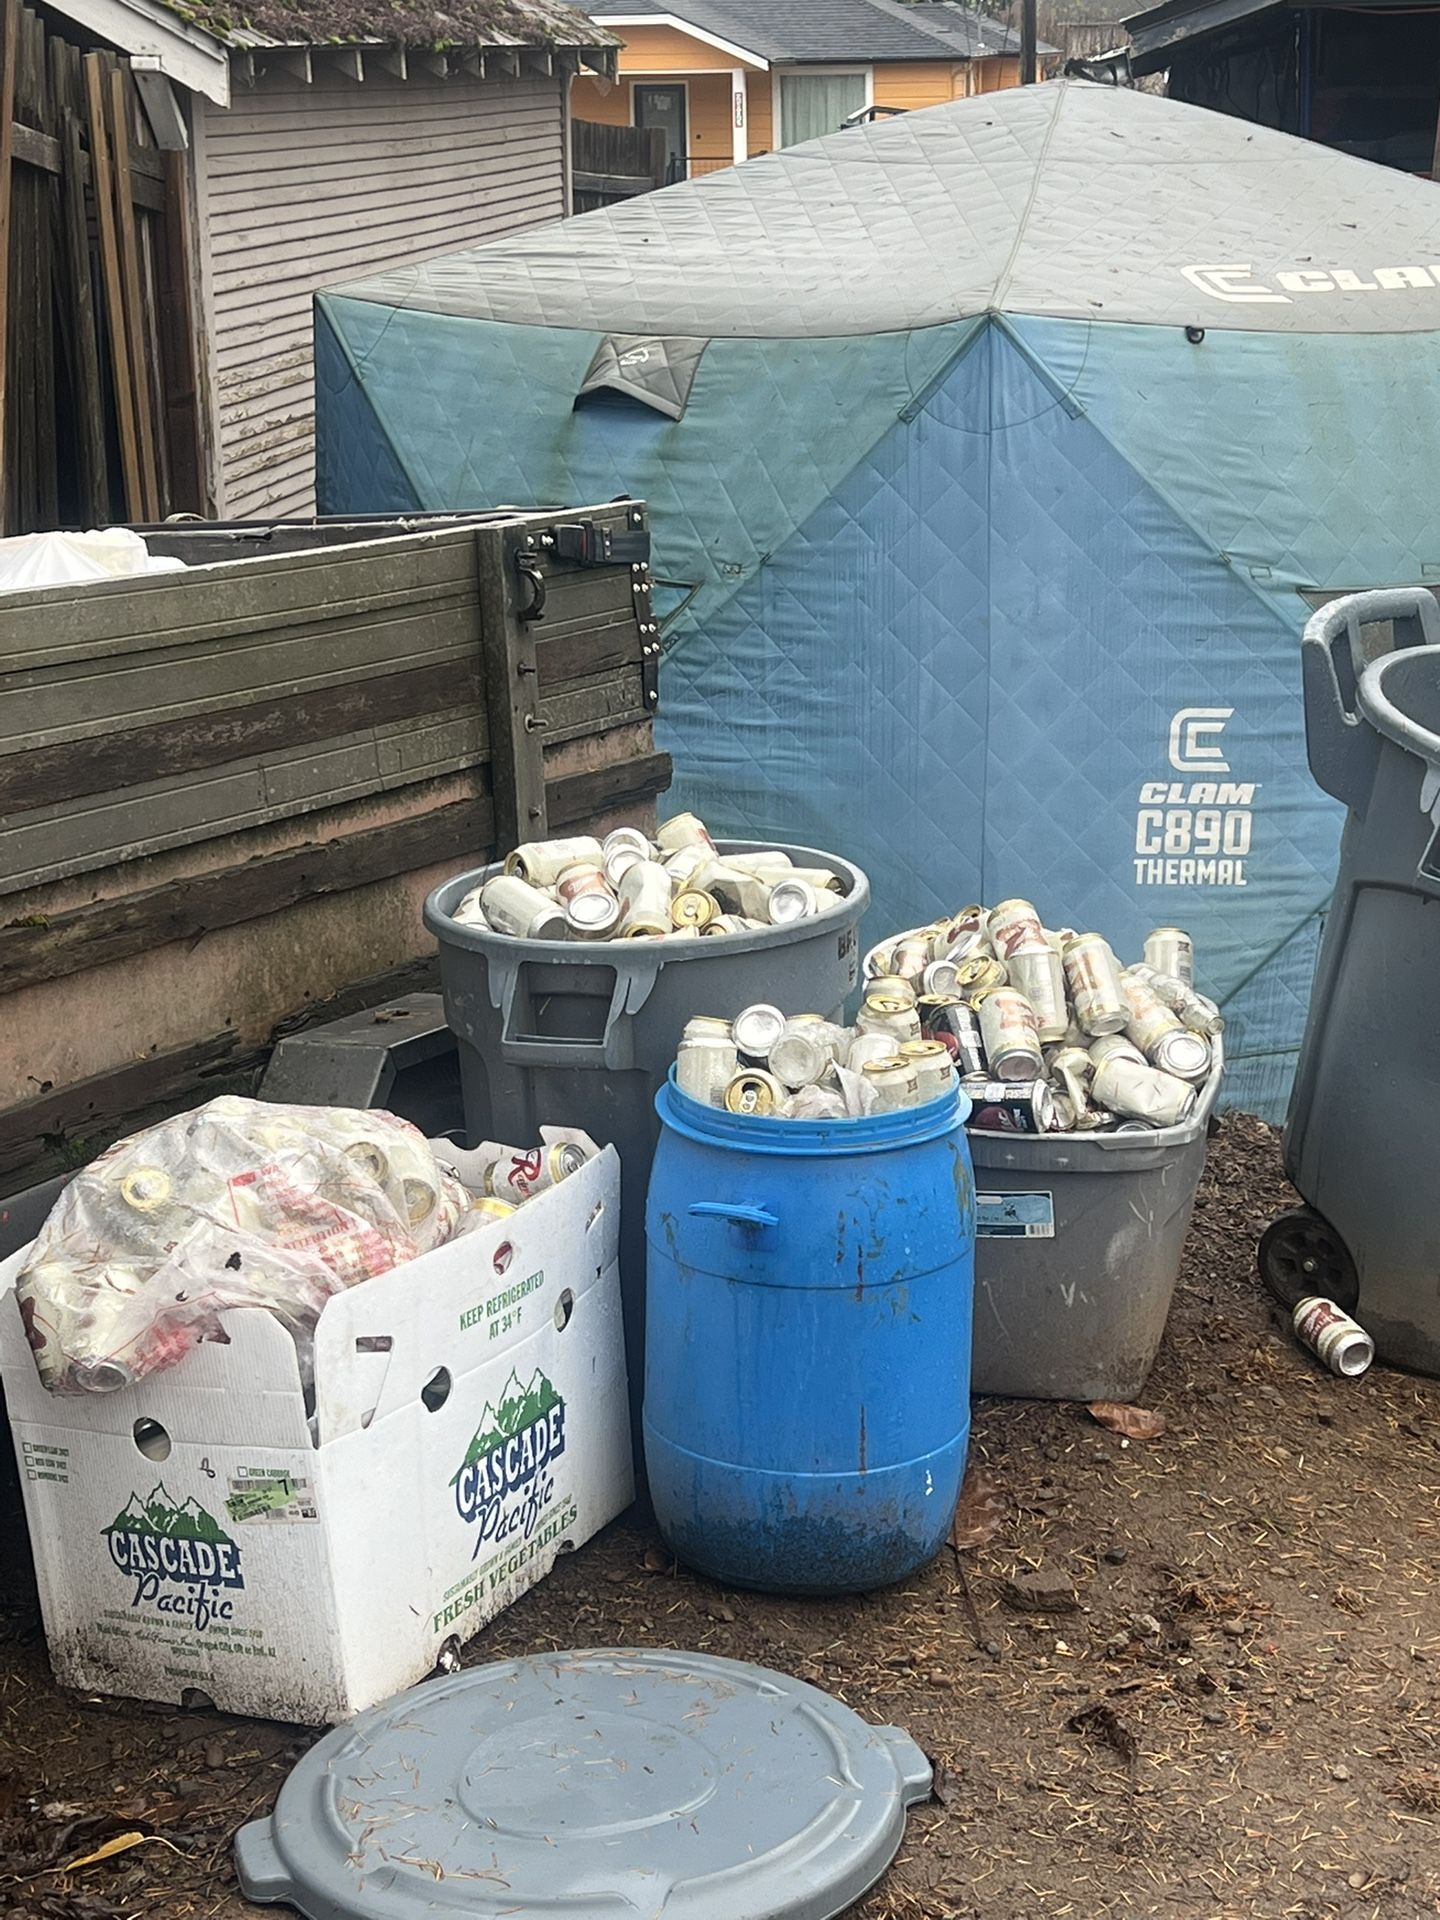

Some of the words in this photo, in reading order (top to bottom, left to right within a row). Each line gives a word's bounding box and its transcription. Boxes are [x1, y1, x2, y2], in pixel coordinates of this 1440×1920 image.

[1275, 265, 1440, 292] CLA
[1139, 783, 1256, 804] CLAM
[1136, 809, 1252, 855] C890
[1133, 859, 1247, 885] THERMAL
[460, 1304, 484, 1331] KEEP
[486, 1269, 544, 1318] REFRIGERATED
[489, 1319, 500, 1340] AT
[458, 1403, 562, 1514] CASCADE
[471, 1467, 554, 1561] Pacific
[109, 1530, 237, 1579] CASCADE
[434, 1580, 485, 1634] FRESH
[488, 1504, 578, 1589] VEGETABLES
[131, 1571, 233, 1631] Pacific
